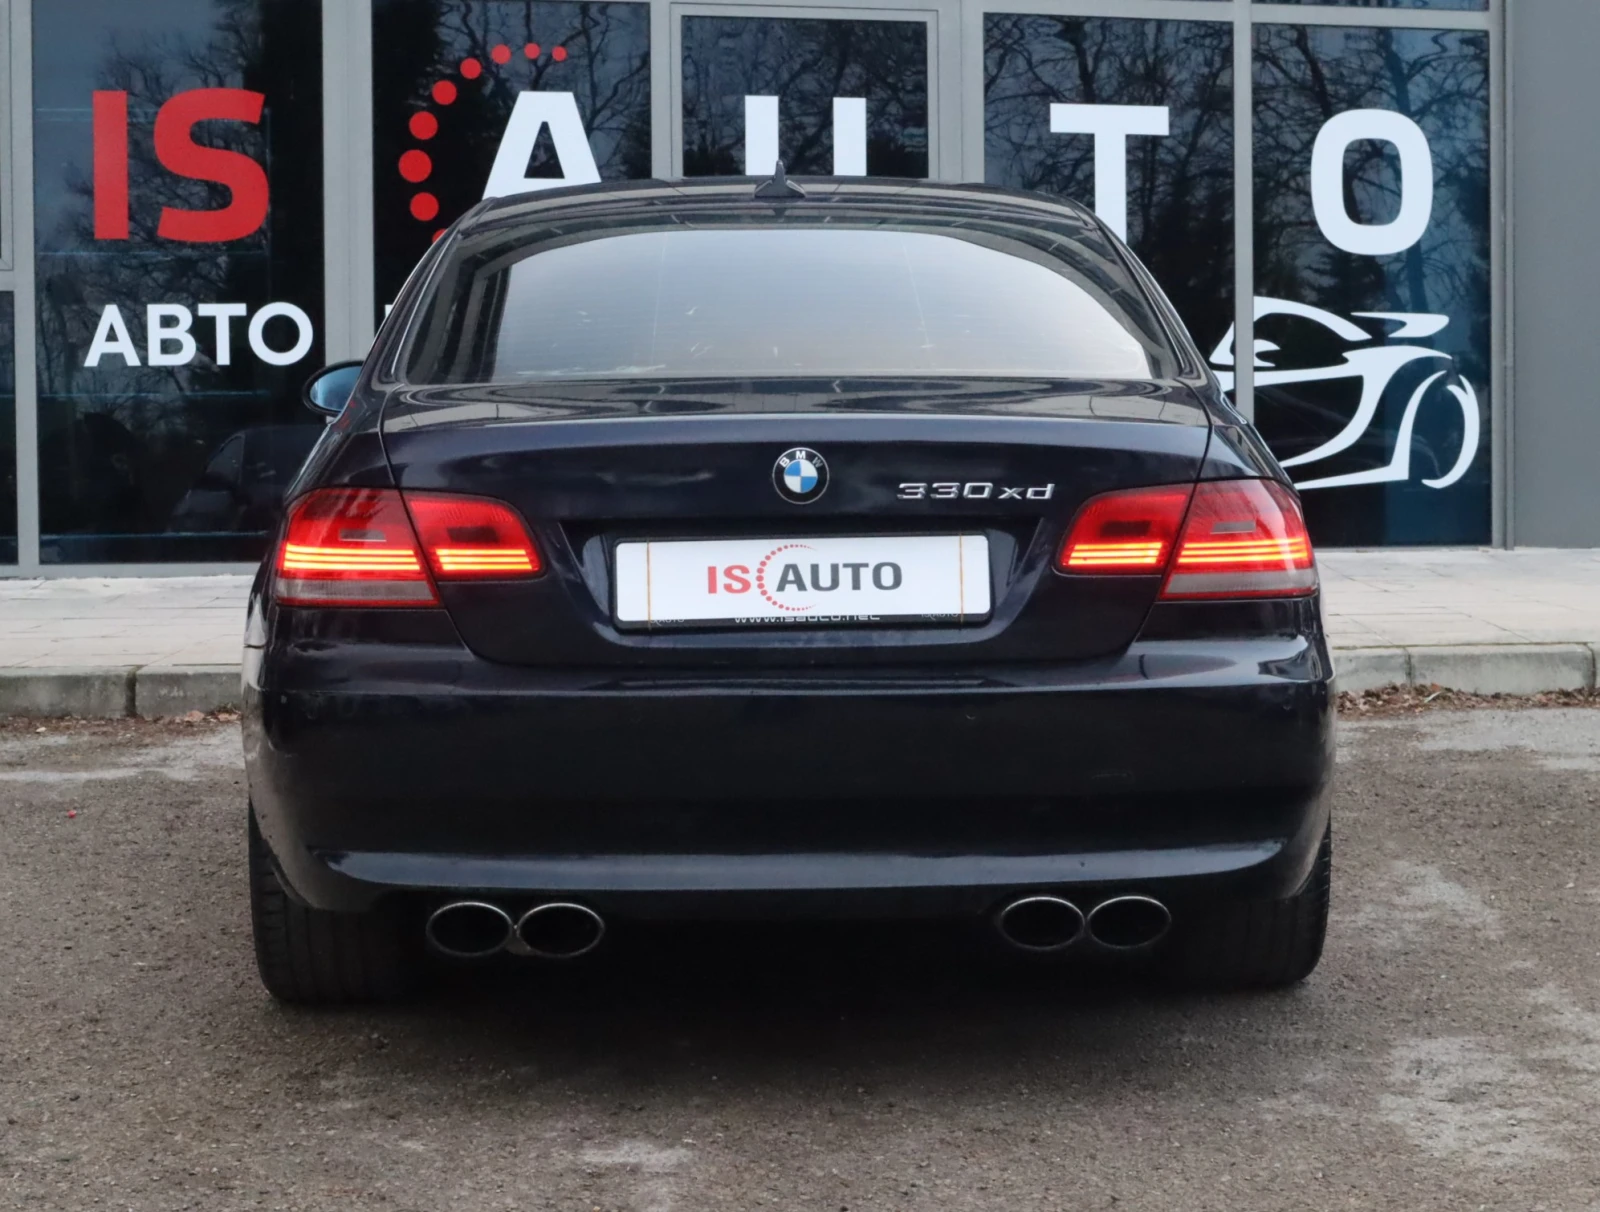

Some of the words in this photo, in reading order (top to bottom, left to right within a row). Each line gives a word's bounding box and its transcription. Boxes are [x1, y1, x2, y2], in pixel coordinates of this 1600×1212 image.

[92, 87, 270, 243] IS
[83, 301, 314, 368] АВТО
[779, 450, 824, 468] BMW
[707, 564, 752, 594] IS
[775, 561, 903, 592] AUTO
